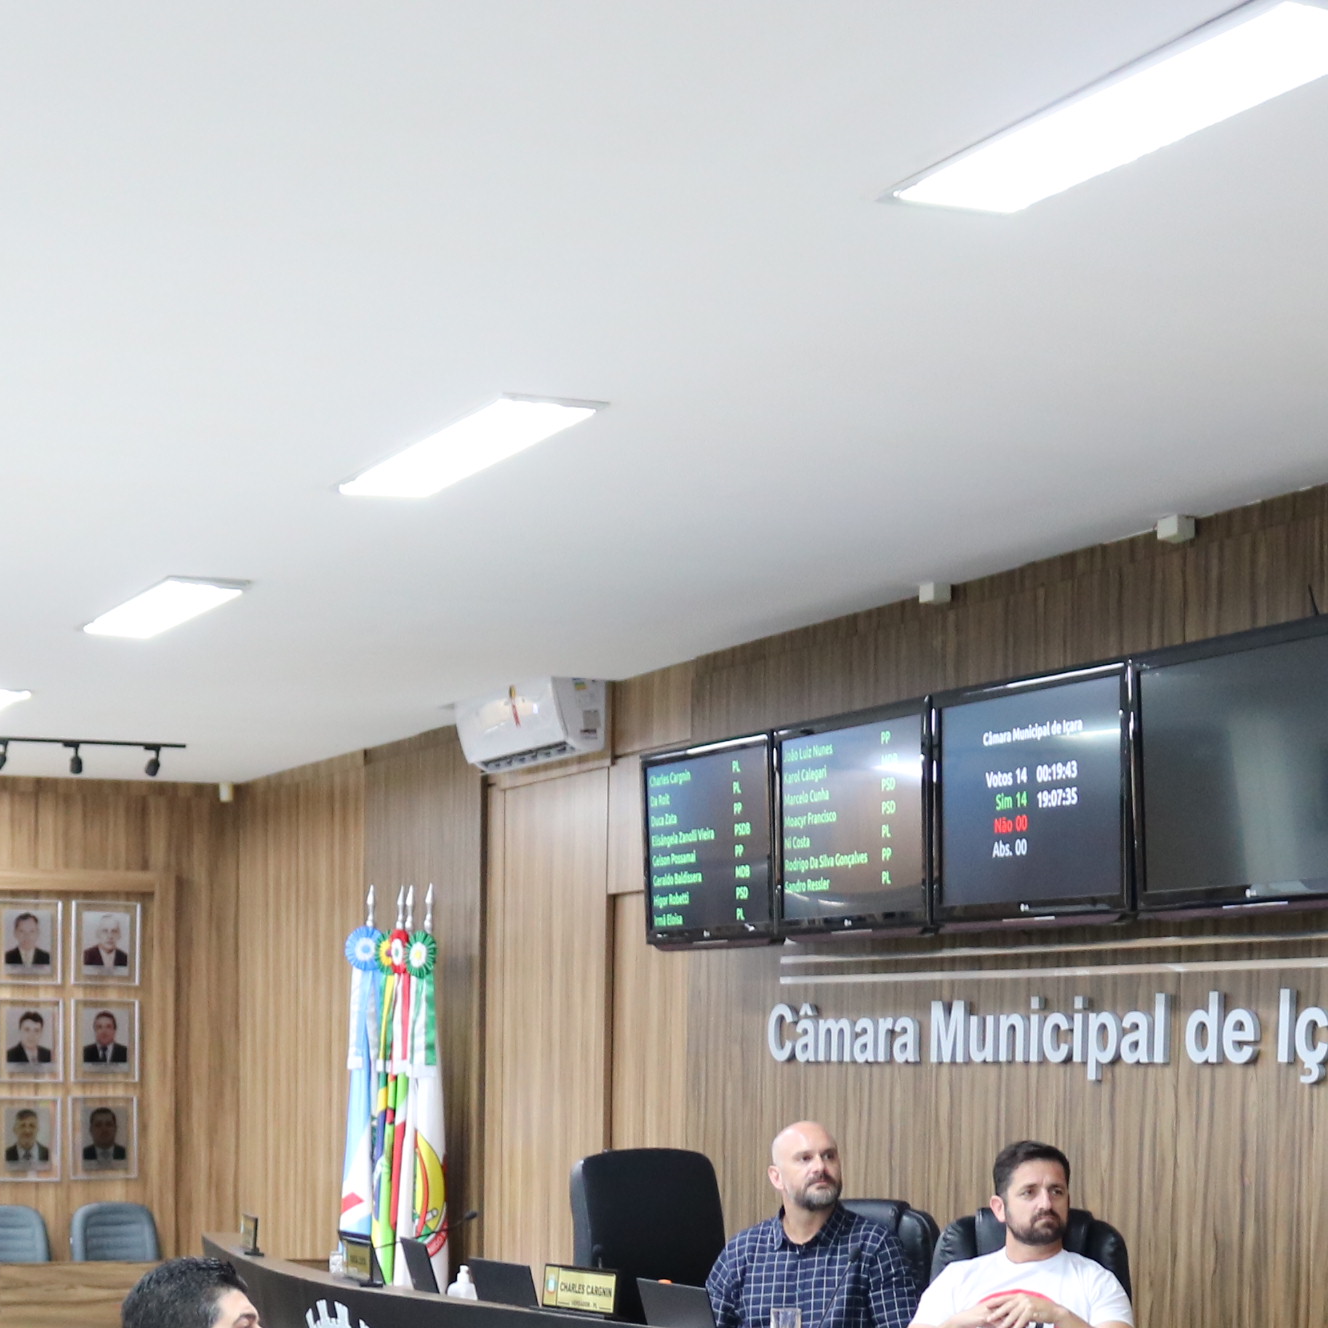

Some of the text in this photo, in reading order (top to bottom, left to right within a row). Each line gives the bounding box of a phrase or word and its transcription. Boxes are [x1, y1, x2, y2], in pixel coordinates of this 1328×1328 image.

[880, 731, 891, 744] PP
[983, 719, 1083, 746] Câmara Municipal de Içara
[732, 760, 740, 773] PL
[1036, 760, 1078, 783] 00:19:43
[881, 777, 896, 792] PSD
[986, 766, 1028, 789] Votos 14
[733, 781, 741, 794] PL
[784, 787, 829, 806] Marcelo Cunha
[995, 791, 1028, 811] Sim 14
[1037, 787, 1078, 808] 19:07:35
[733, 802, 742, 815] PP
[882, 800, 896, 815] PSD
[808, 810, 836, 826] Francisco
[994, 814, 1028, 834] Não 00
[734, 822, 751, 837] PSDB
[881, 824, 892, 838] PL
[792, 835, 810, 849] Costa
[992, 838, 1028, 859] Abs. 00
[734, 844, 744, 857] PP
[882, 847, 892, 861] PP
[784, 851, 868, 873] Rodrigo Da Silva Gonçalves
[735, 865, 750, 879] MDB
[881, 871, 892, 884] PL
[807, 877, 830, 891] Ressler
[736, 886, 749, 900] PSD
[736, 908, 745, 920] PL
[767, 1002, 921, 1064] Câmara
[929, 992, 1173, 1082] Municipal
[1185, 990, 1261, 1064] de
[560, 1281, 613, 1298] CHARLES CARGNIN
